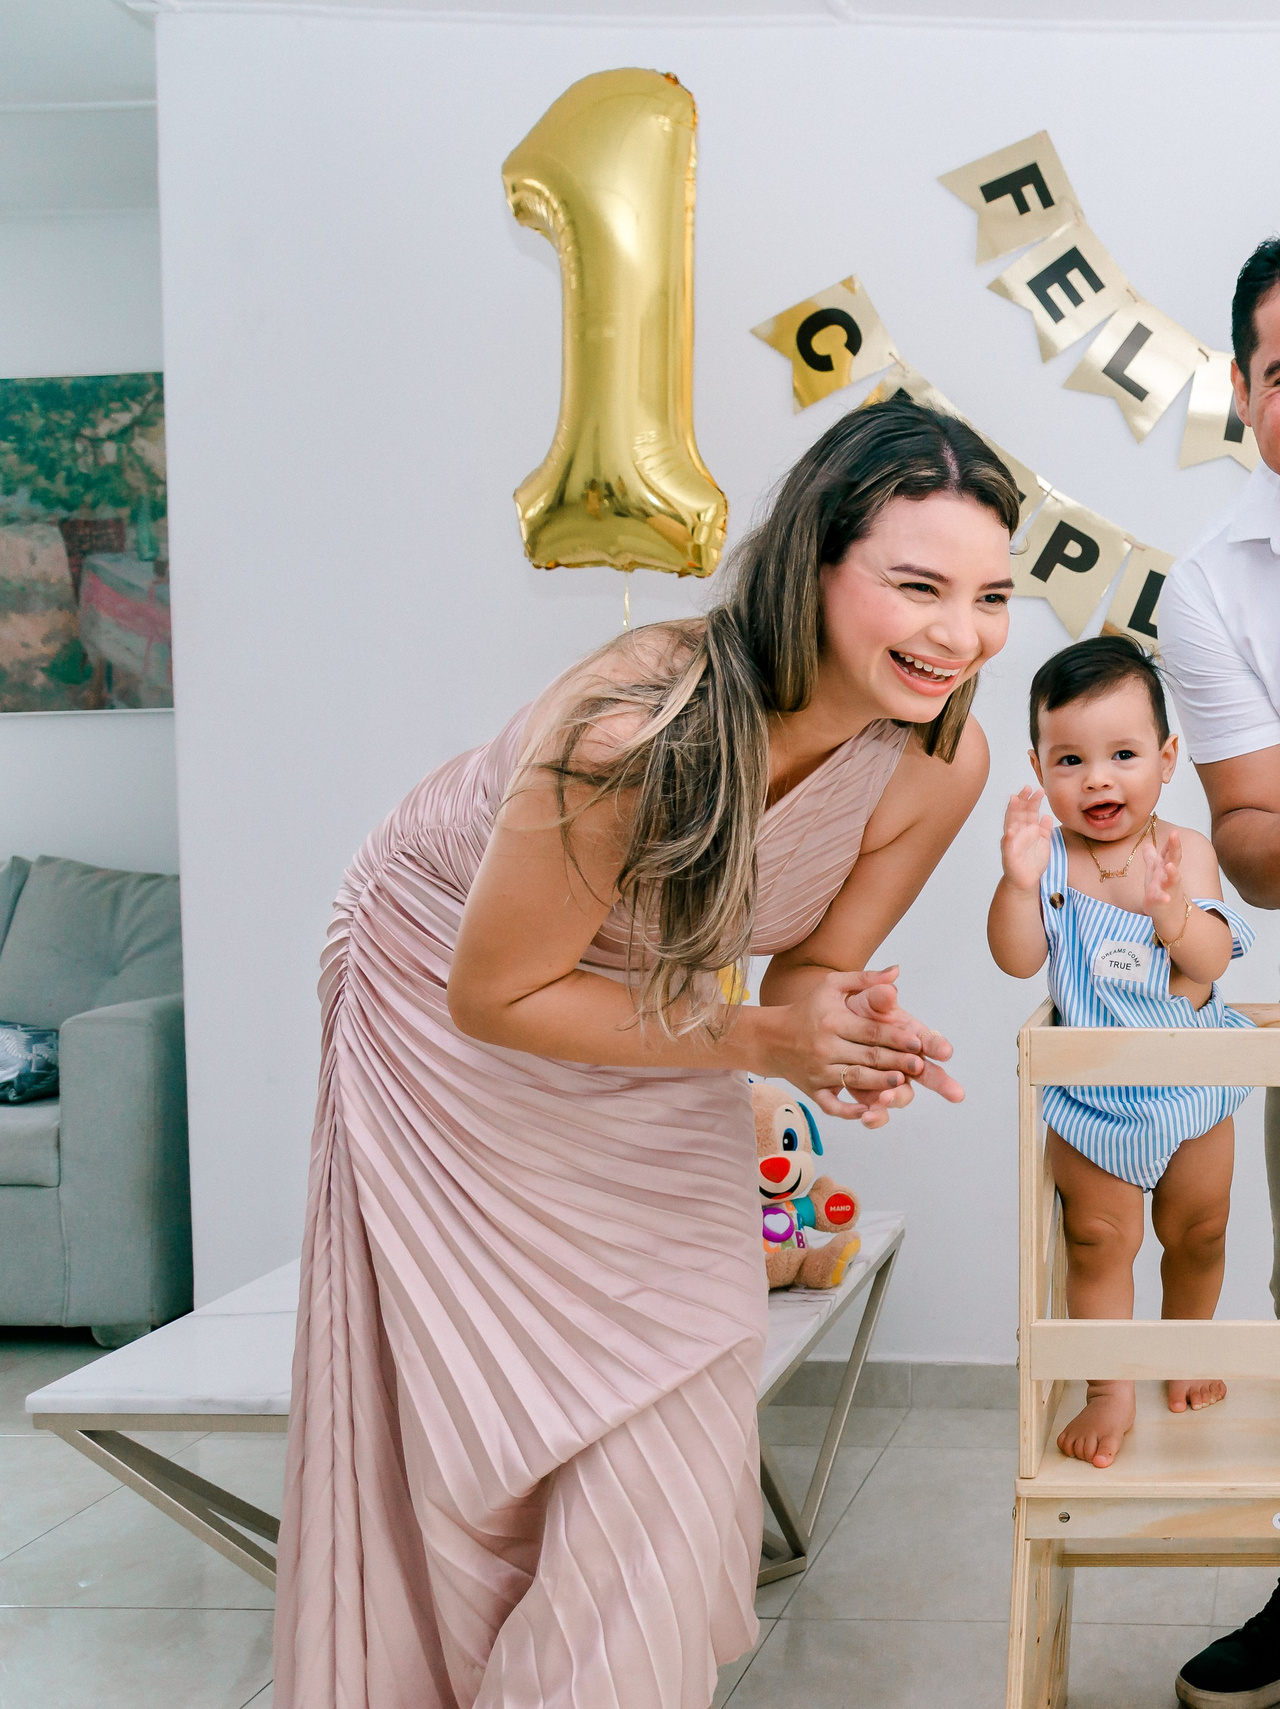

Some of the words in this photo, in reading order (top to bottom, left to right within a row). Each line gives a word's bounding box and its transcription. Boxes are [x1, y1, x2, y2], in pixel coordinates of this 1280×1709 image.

[1101, 948, 1126, 960] DREAMS
[1128, 951, 1141, 967] COME
[1109, 960, 1132, 971] TRUE
